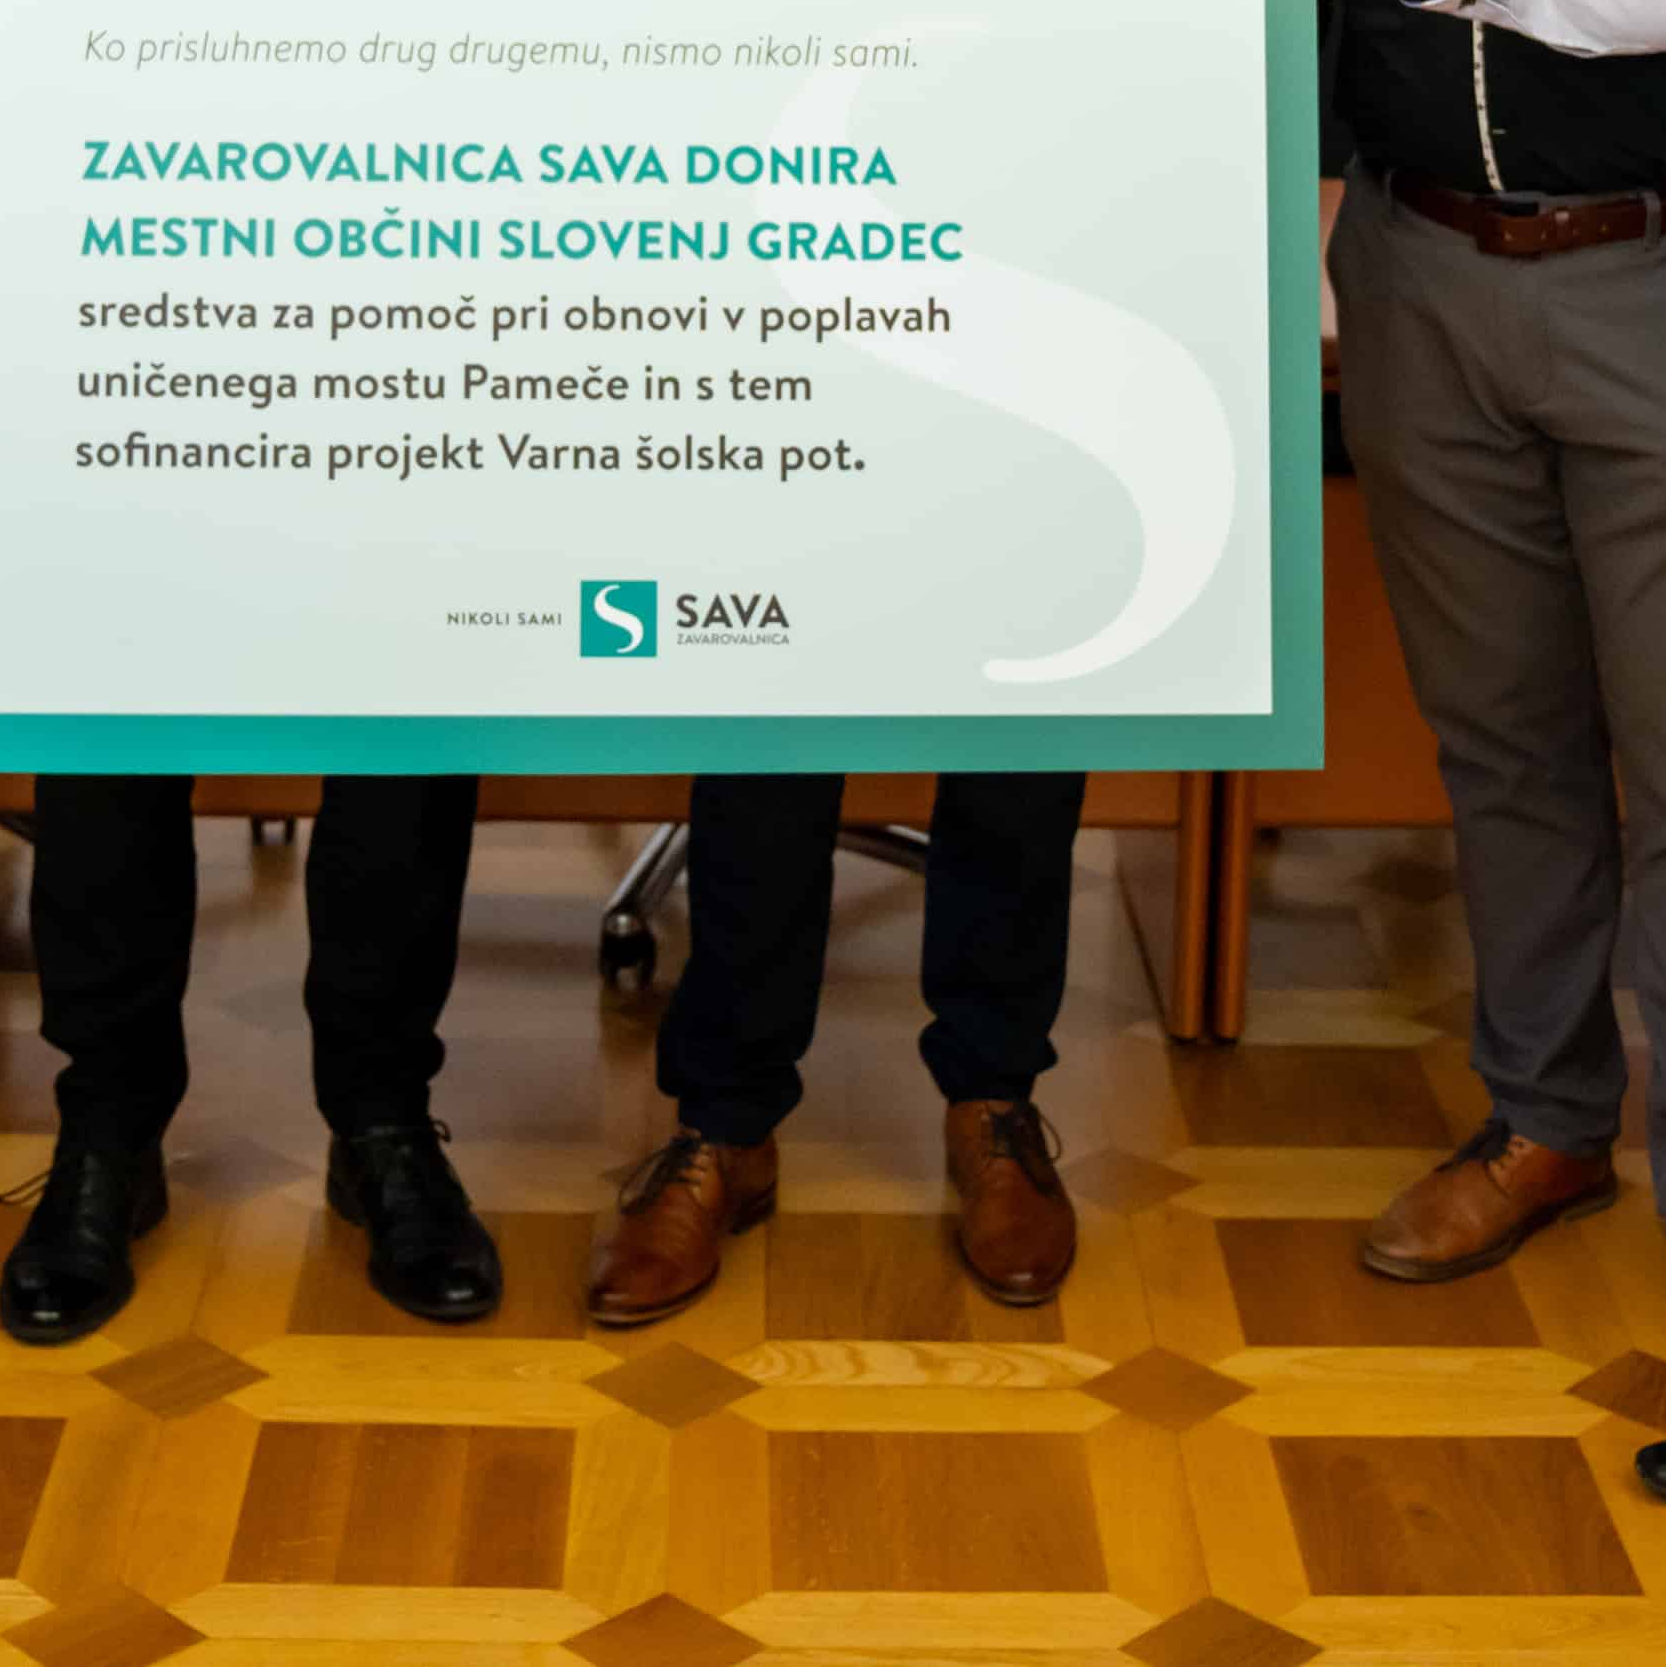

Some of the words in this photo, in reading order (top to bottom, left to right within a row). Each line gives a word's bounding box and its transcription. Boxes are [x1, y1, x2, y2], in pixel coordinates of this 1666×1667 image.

[85, 30, 125, 62] Ko
[136, 30, 346, 70] prisluhnemo
[357, 31, 436, 73] drug
[449, 33, 608, 73] drugemu,
[623, 35, 722, 68] nismo
[734, 34, 821, 68] nikoli
[833, 37, 918, 67] sami.
[82, 140, 524, 184] ZAVAROVALNICA
[538, 143, 669, 185] SAVA
[686, 144, 897, 187] DONIRA
[81, 215, 274, 258] MESTNI
[293, 207, 481, 260] OBČINI
[499, 218, 730, 262] SLOVENJ
[747, 220, 962, 262] GRADEC
[78, 291, 258, 330] sredstva
[271, 302, 314, 332] za
[329, 294, 477, 342] pomoč
[491, 294, 549, 344] pri
[563, 294, 708, 332] obnovi
[721, 304, 746, 333] v
[760, 295, 952, 344] poplavah
[77, 360, 297, 410] uničenega
[313, 367, 445, 402] mostu
[463, 362, 629, 401] Pameče
[645, 364, 681, 401] in
[696, 375, 715, 402] s
[728, 368, 812, 402] tem
[75, 430, 312, 470] sofinancira
[327, 432, 485, 482] projekt
[497, 433, 621, 471] Varna
[635, 433, 764, 473] šolska
[779, 438, 866, 483] pot.
[446, 611, 509, 626] NIKOLI
[517, 611, 562, 626] SAMI
[676, 594, 790, 629] SAVA
[676, 633, 790, 646] ZAVAROVALNICA
